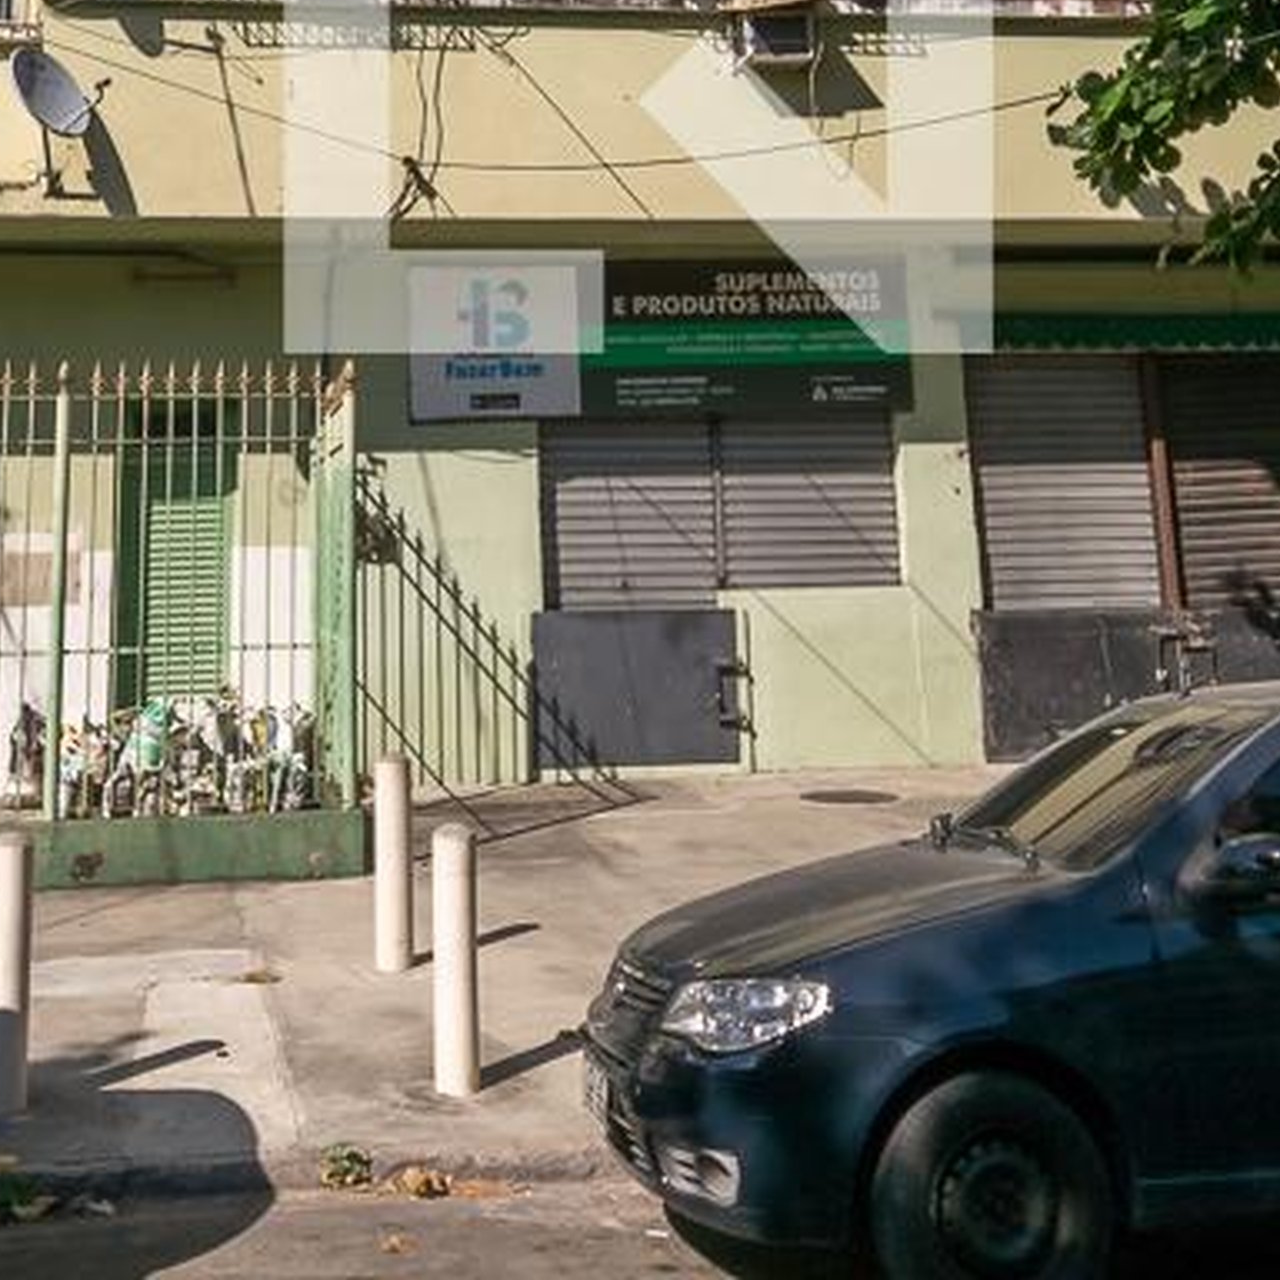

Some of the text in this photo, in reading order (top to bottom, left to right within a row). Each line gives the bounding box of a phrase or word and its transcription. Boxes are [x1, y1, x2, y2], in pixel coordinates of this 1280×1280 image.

[714, 271, 880, 293] SUPLEMENTOS
[612, 291, 881, 316] E PRODUTOS NATURAIS
